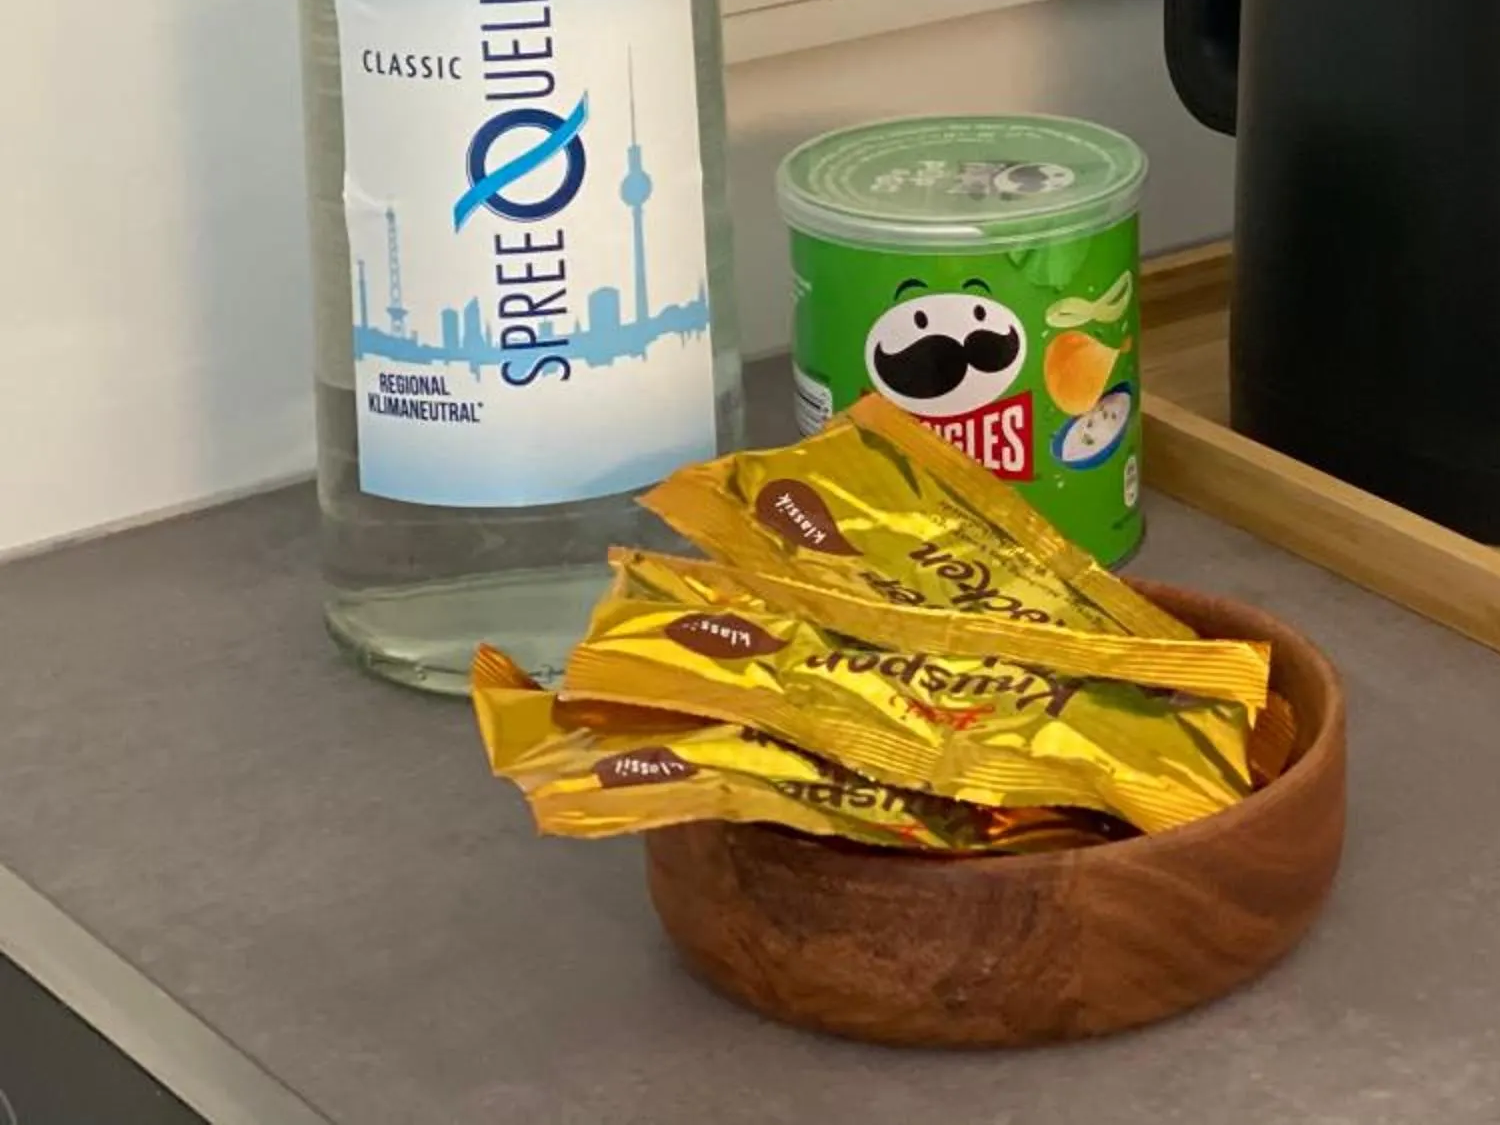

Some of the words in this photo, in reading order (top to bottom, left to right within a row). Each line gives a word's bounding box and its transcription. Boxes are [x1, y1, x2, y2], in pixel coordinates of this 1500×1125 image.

[362, 50, 462, 80] CLASSIC
[379, 373, 451, 396] REGIONAL
[920, 404, 1025, 472] GLES
[774, 491, 827, 545] klassik
